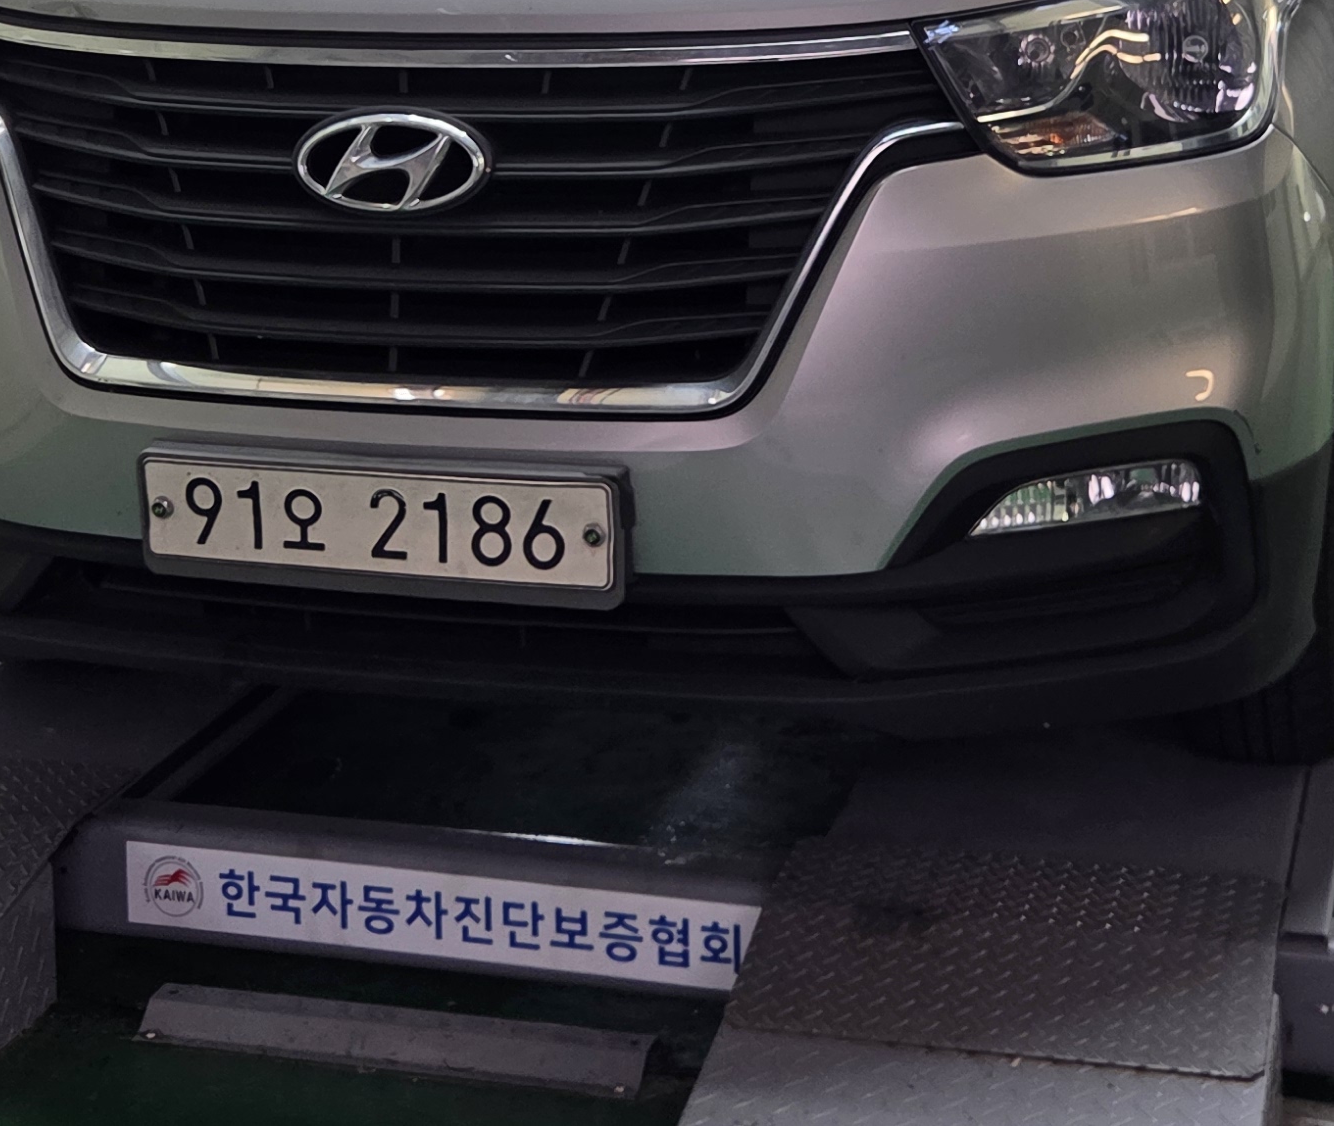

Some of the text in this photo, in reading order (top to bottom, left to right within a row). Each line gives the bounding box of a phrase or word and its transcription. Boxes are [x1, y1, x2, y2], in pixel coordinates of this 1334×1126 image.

[185, 476, 566, 571] 91오 2186
[154, 887, 196, 903] KAIWA
[218, 868, 742, 974] 한국자동차진단보증협회
